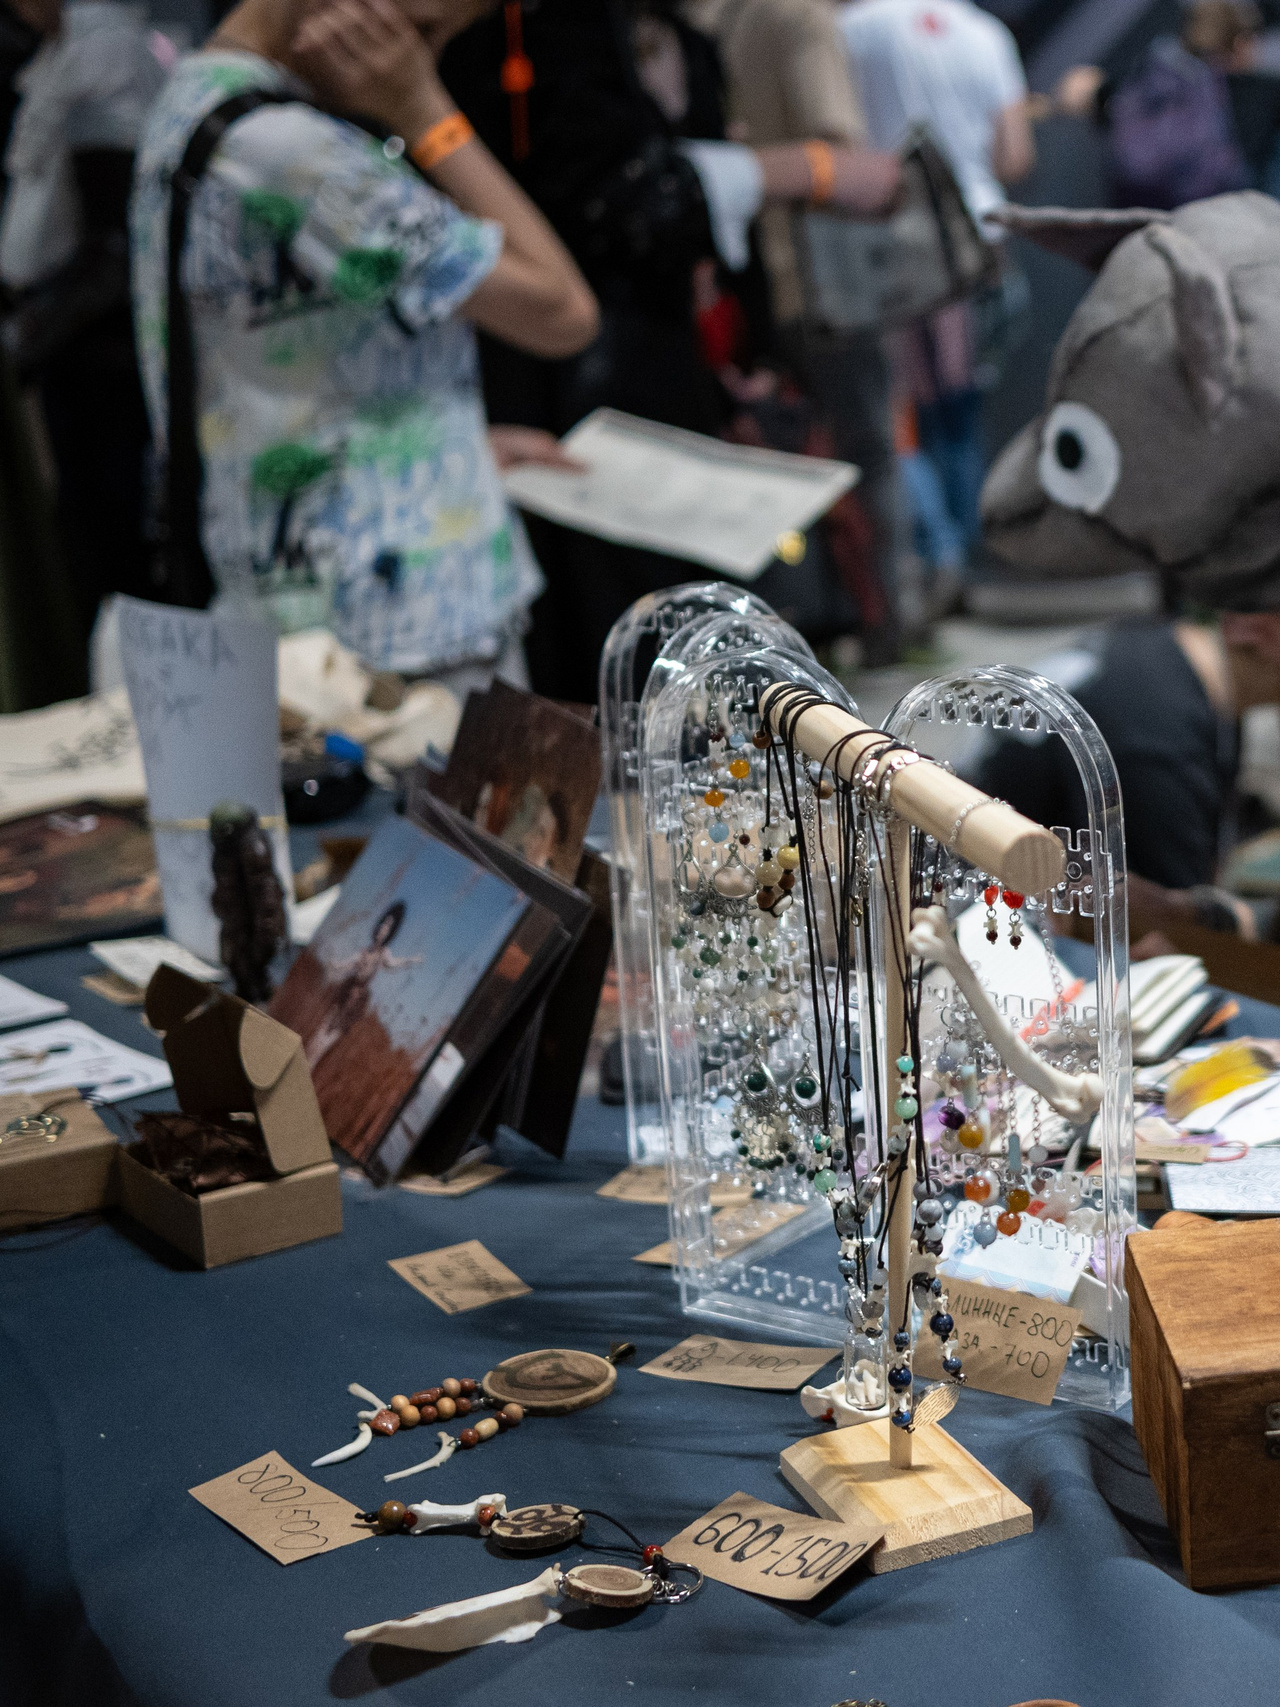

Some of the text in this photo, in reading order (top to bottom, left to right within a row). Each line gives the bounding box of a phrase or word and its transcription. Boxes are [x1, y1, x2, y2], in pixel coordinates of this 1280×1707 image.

[1004, 1343, 1050, 1378] 700
[238, 1463, 339, 1550] 800/500
[693, 1512, 868, 1583] 600-1500
